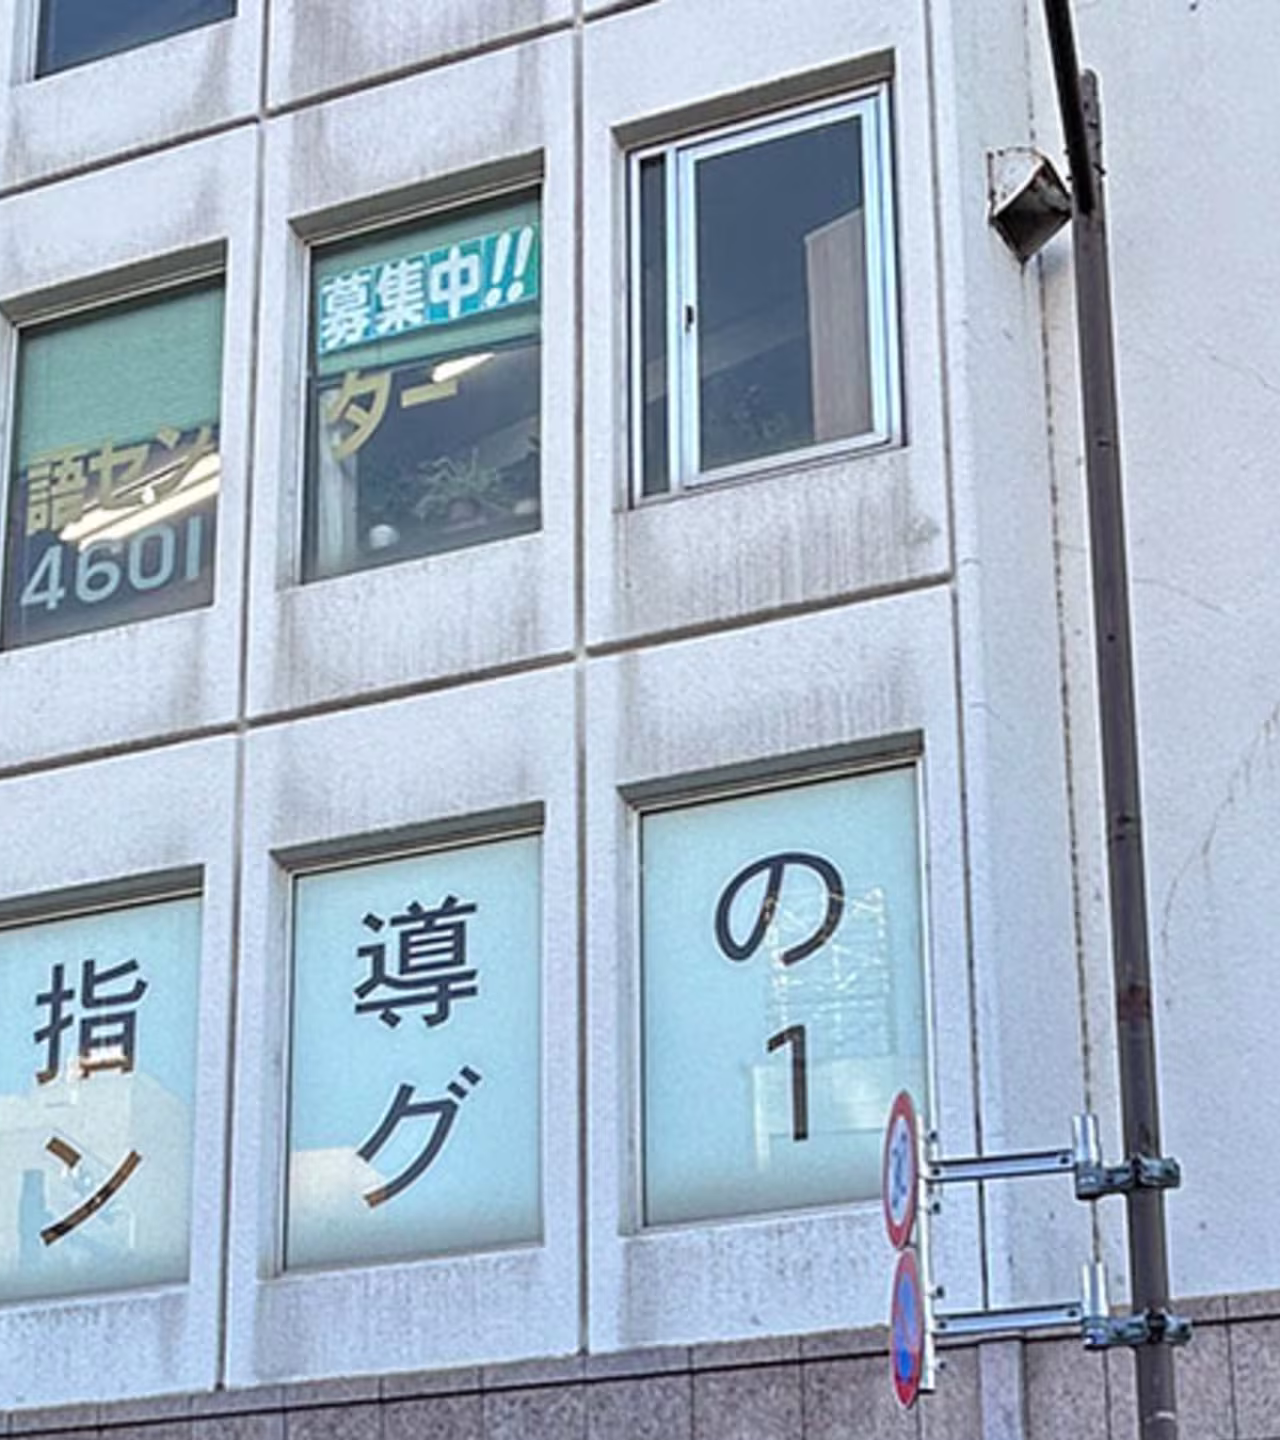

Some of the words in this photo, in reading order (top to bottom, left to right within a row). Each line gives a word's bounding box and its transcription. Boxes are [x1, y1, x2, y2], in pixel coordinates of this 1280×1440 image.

[320, 226, 533, 350] 募集中!!
[20, 516, 203, 610] 4601
